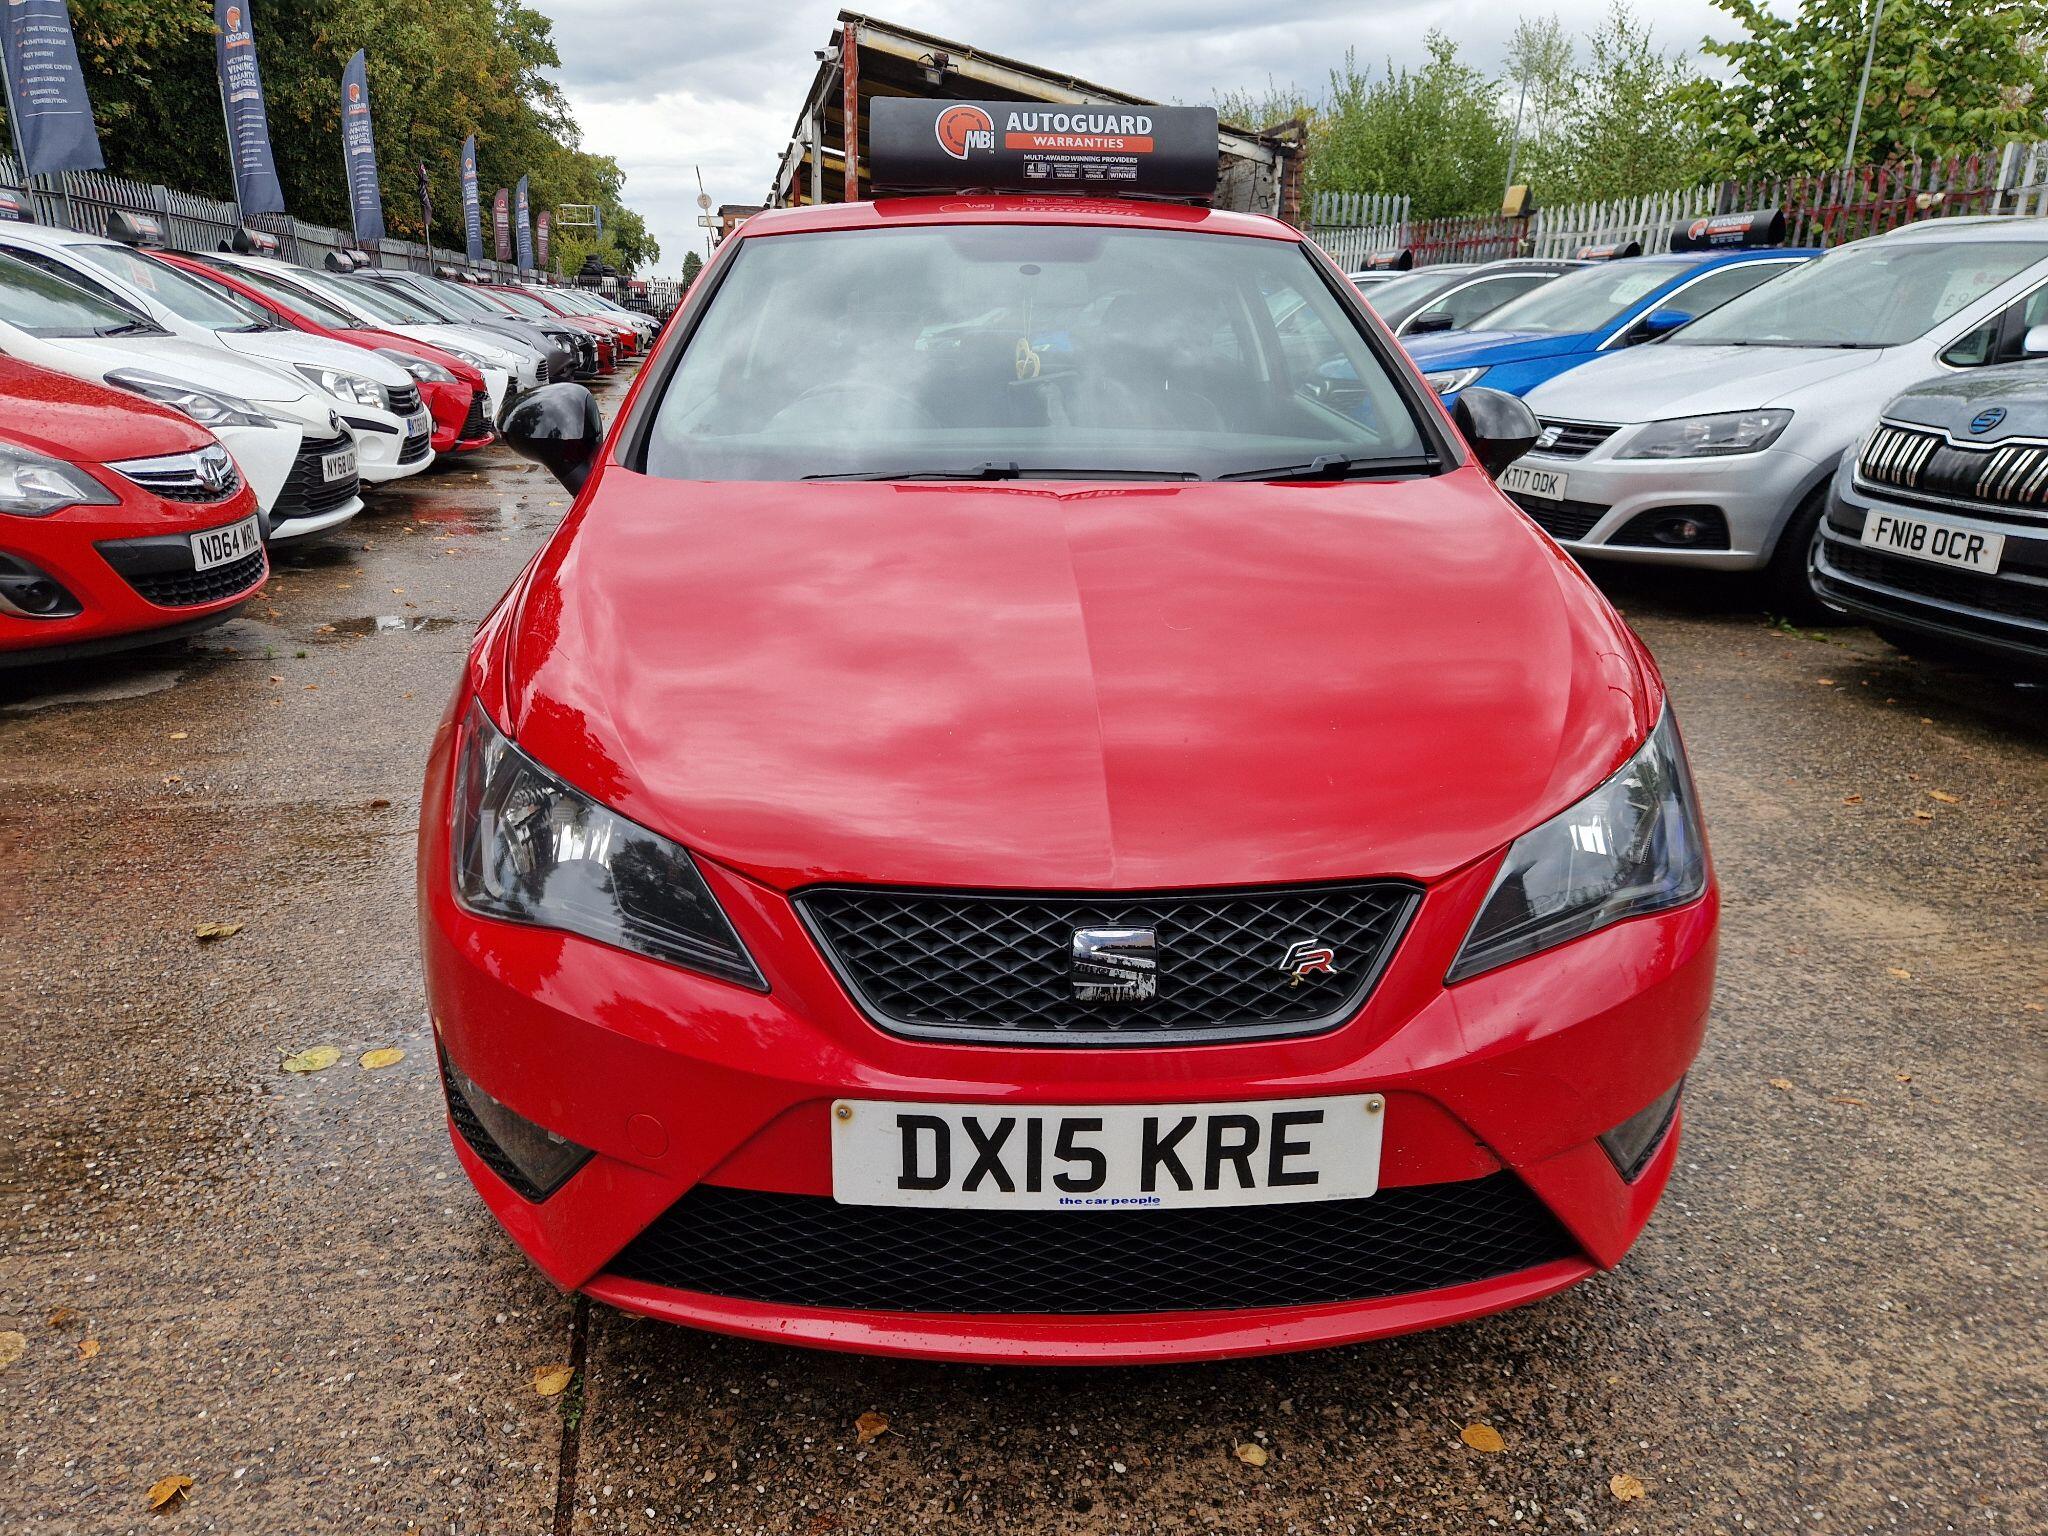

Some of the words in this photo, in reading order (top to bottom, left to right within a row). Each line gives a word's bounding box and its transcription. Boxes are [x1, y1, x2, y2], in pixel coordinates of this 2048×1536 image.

[1006, 112, 1153, 135] AUTOGUARD
[1033, 136, 1124, 149] WARRANTIES
[1024, 154, 1070, 162] MULTI-AWARD
[1070, 155, 1100, 163] WINNING
[1101, 156, 1138, 164] PROVIDERS
[327, 455, 347, 477] NY68
[1502, 466, 1530, 489] KT17
[1531, 472, 1559, 495] ODK
[200, 530, 240, 564] ND64
[240, 523, 258, 551] WRL
[1875, 517, 1927, 551] FN18
[1931, 528, 1985, 564] OCR
[1278, 938, 1338, 975] FR
[897, 1114, 1107, 1193] DX15
[1140, 1109, 1325, 1193] KRE
[1059, 1197, 1083, 1205] the
[1111, 1196, 1161, 1206] people
